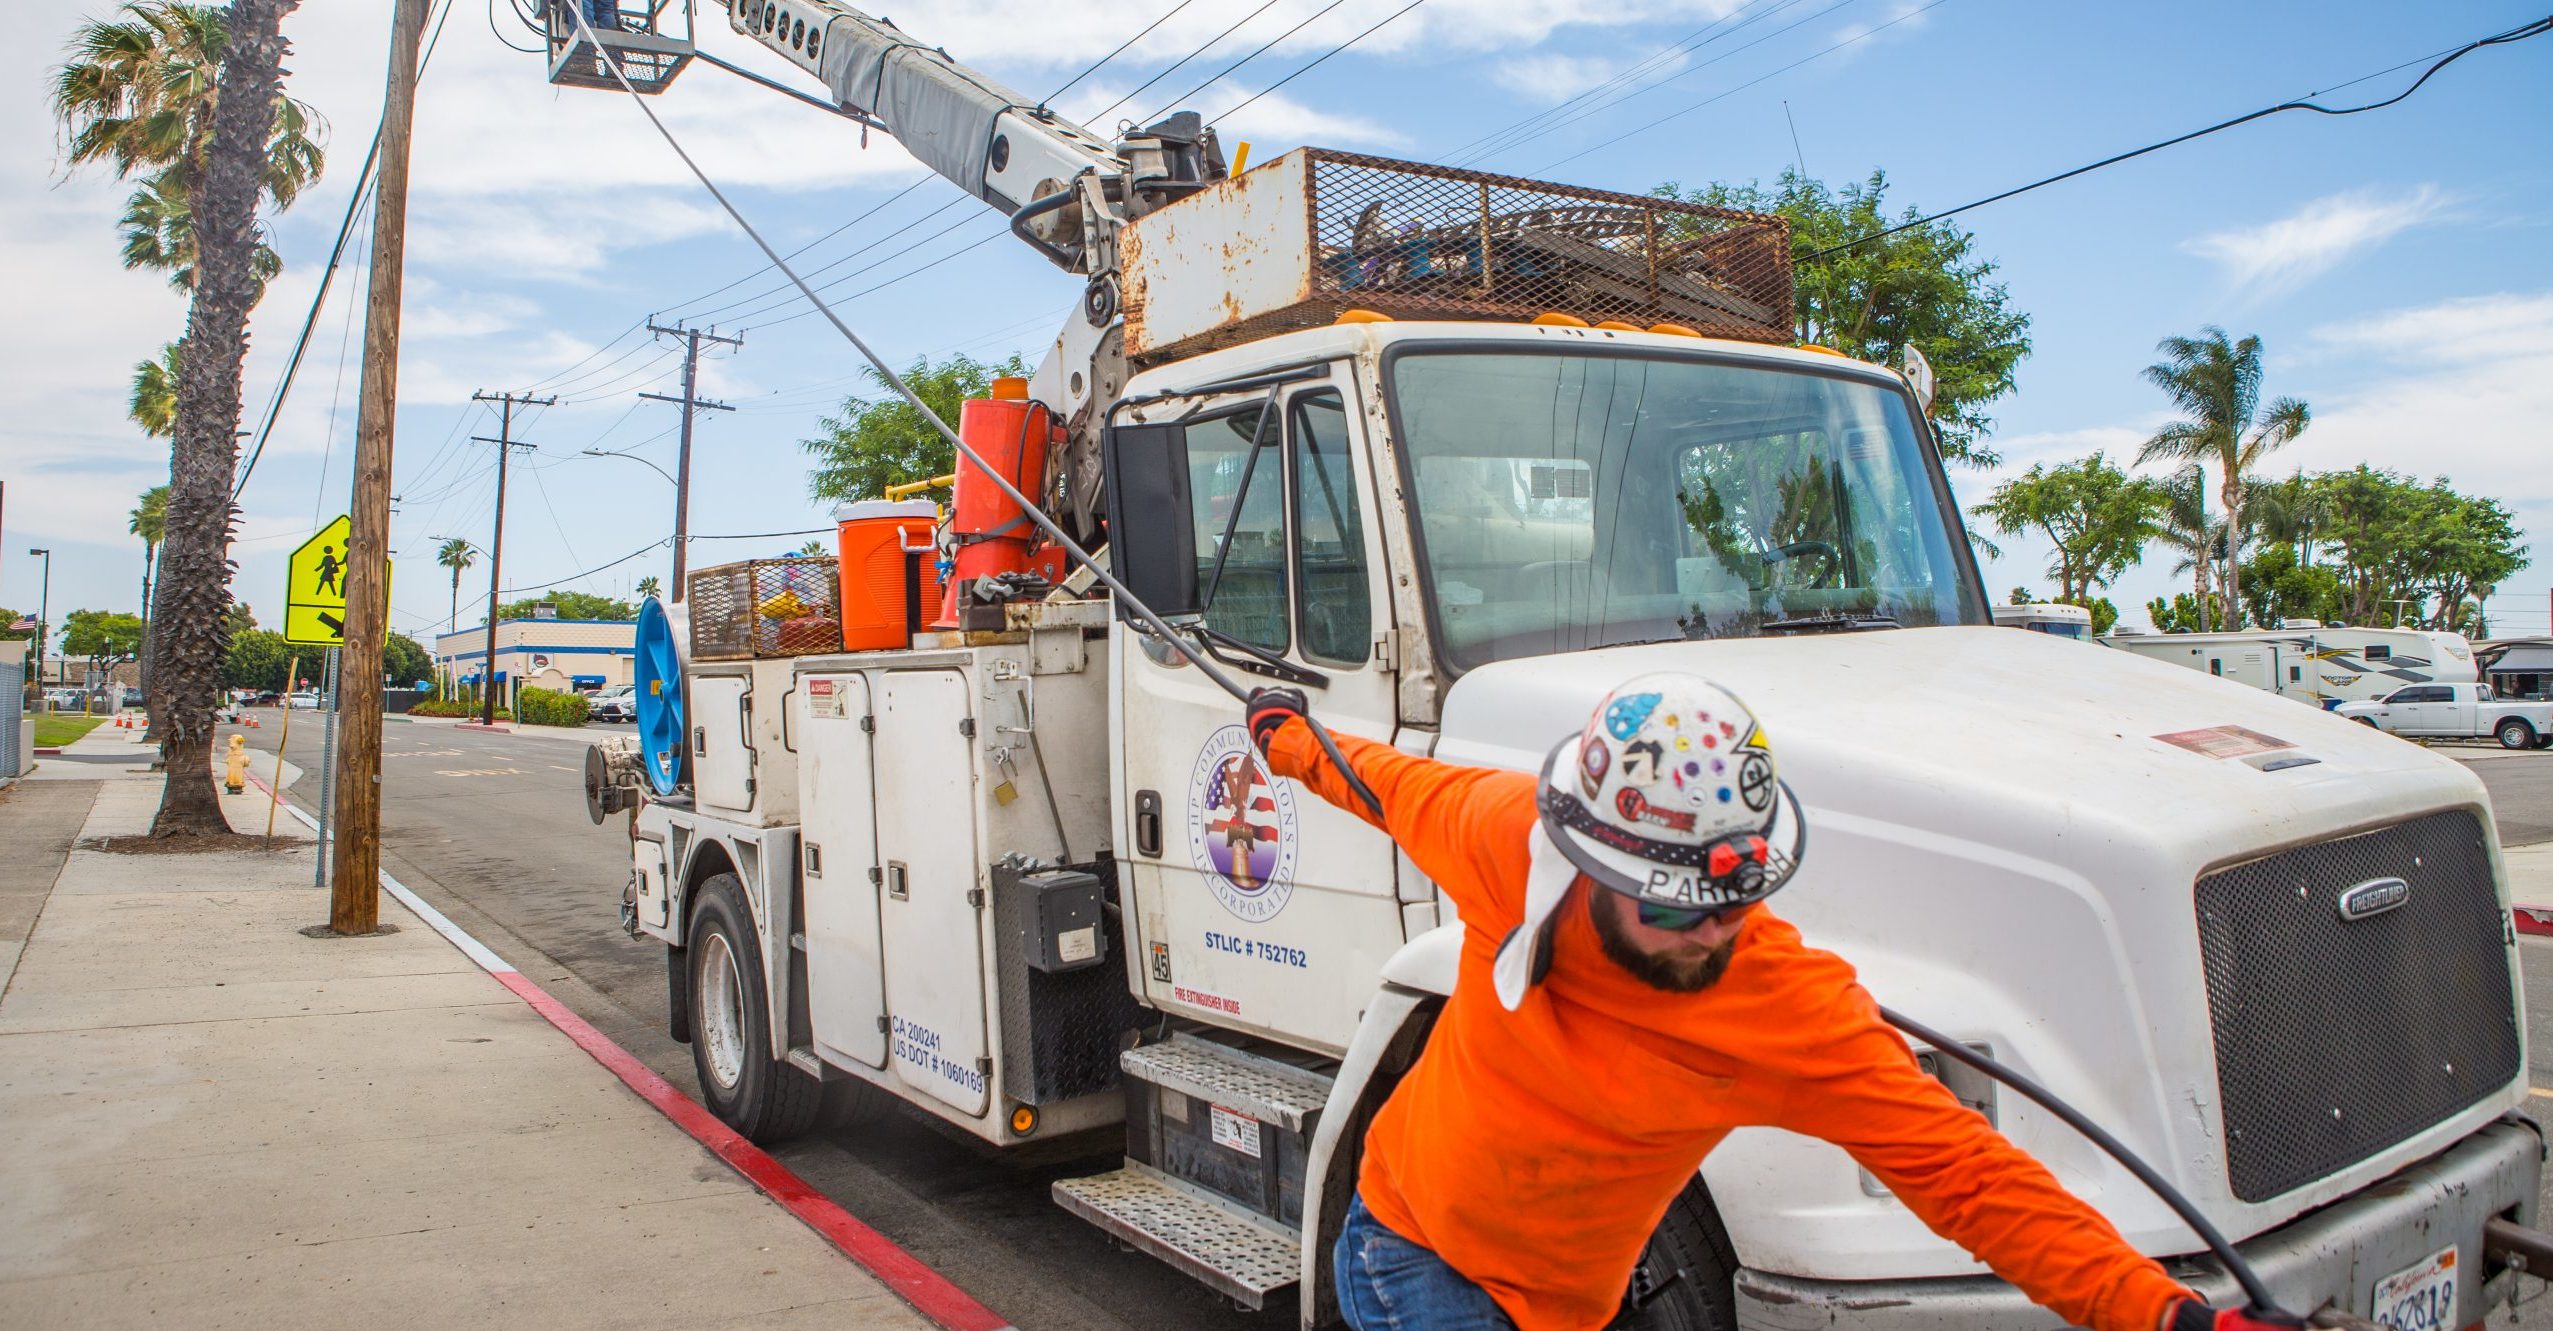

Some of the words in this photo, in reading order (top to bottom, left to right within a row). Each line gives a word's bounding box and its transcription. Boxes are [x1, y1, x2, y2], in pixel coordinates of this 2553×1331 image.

[815, 684, 831, 692] DANGER
[1191, 798, 1201, 826] HP
[1196, 853, 1291, 917] INCORPORATED
[2351, 885, 2404, 912] FREIGHTLINER
[1154, 953, 1168, 979] 45
[1245, 940, 1253, 957] #
[1257, 942, 1307, 968] 752762
[1174, 987, 1186, 1001] FIRE
[1187, 989, 1222, 1010] EXTINGUISHER
[1223, 998, 1241, 1015] INSIDE
[892, 1015, 906, 1036] CA
[908, 1022, 940, 1052] 200241
[893, 1037, 906, 1058] US
[908, 1044, 929, 1069] DOT
[932, 1055, 938, 1073] #
[941, 1059, 983, 1093] 1060169
